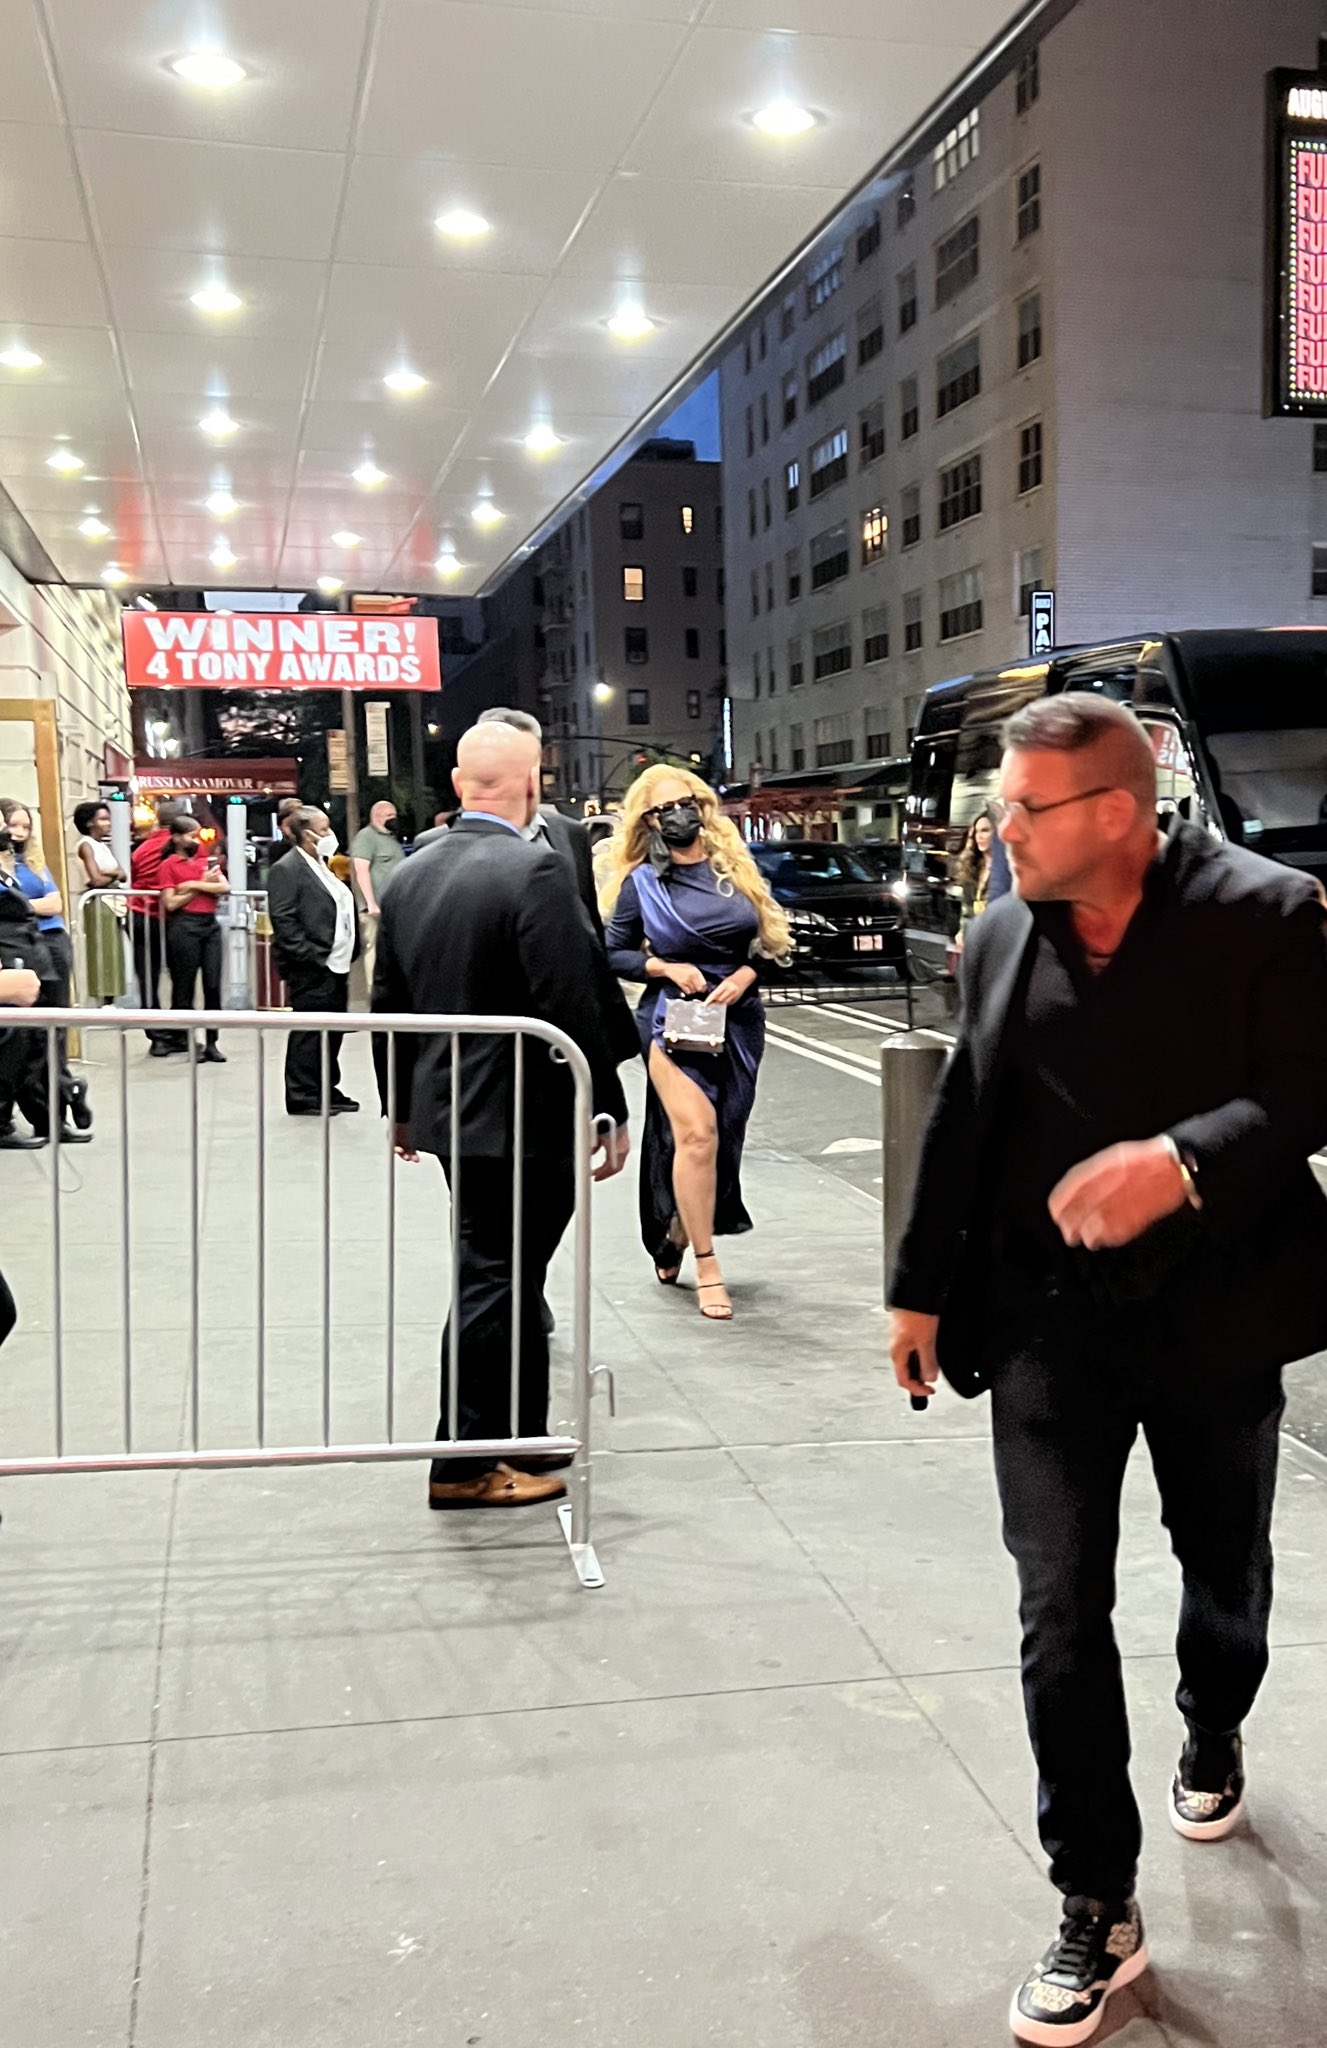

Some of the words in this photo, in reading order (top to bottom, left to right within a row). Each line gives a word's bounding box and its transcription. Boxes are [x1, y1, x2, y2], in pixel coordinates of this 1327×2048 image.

[143, 617, 417, 654] WINNER!
[1035, 612, 1051, 653] PA
[146, 652, 169, 679] 4
[175, 651, 272, 681] TONY
[279, 653, 421, 683] AWARDS
[139, 775, 190, 789] RUSSIAN
[193, 777, 253, 789] SAMOVAR
